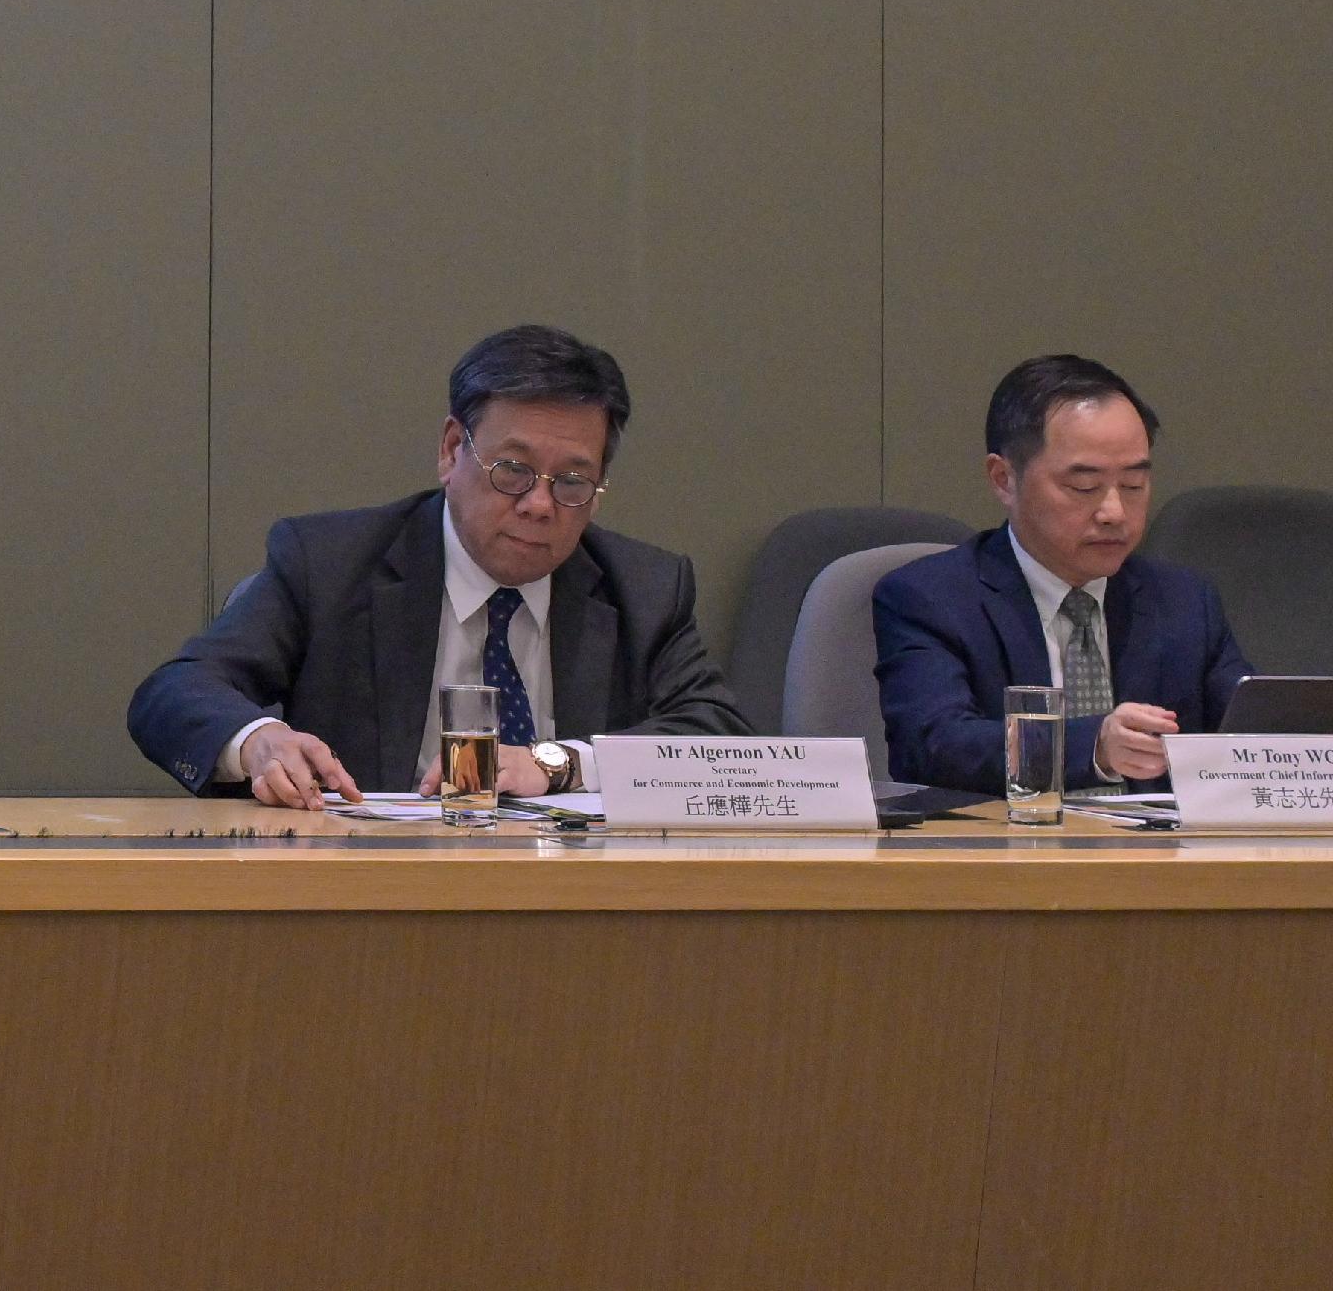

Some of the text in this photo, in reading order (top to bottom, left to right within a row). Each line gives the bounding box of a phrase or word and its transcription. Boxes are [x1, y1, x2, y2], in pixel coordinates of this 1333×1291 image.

[657, 745, 806, 764] Mr Algernon YAU
[1232, 748, 1258, 763] Mr
[1261, 748, 1300, 768] Tony
[711, 766, 757, 777] Secretary
[1198, 769, 1266, 780] Government
[1268, 770, 1299, 780] Chief
[633, 778, 839, 791] for Commerce and Economic Development
[684, 794, 800, 817] 丘應樺先生
